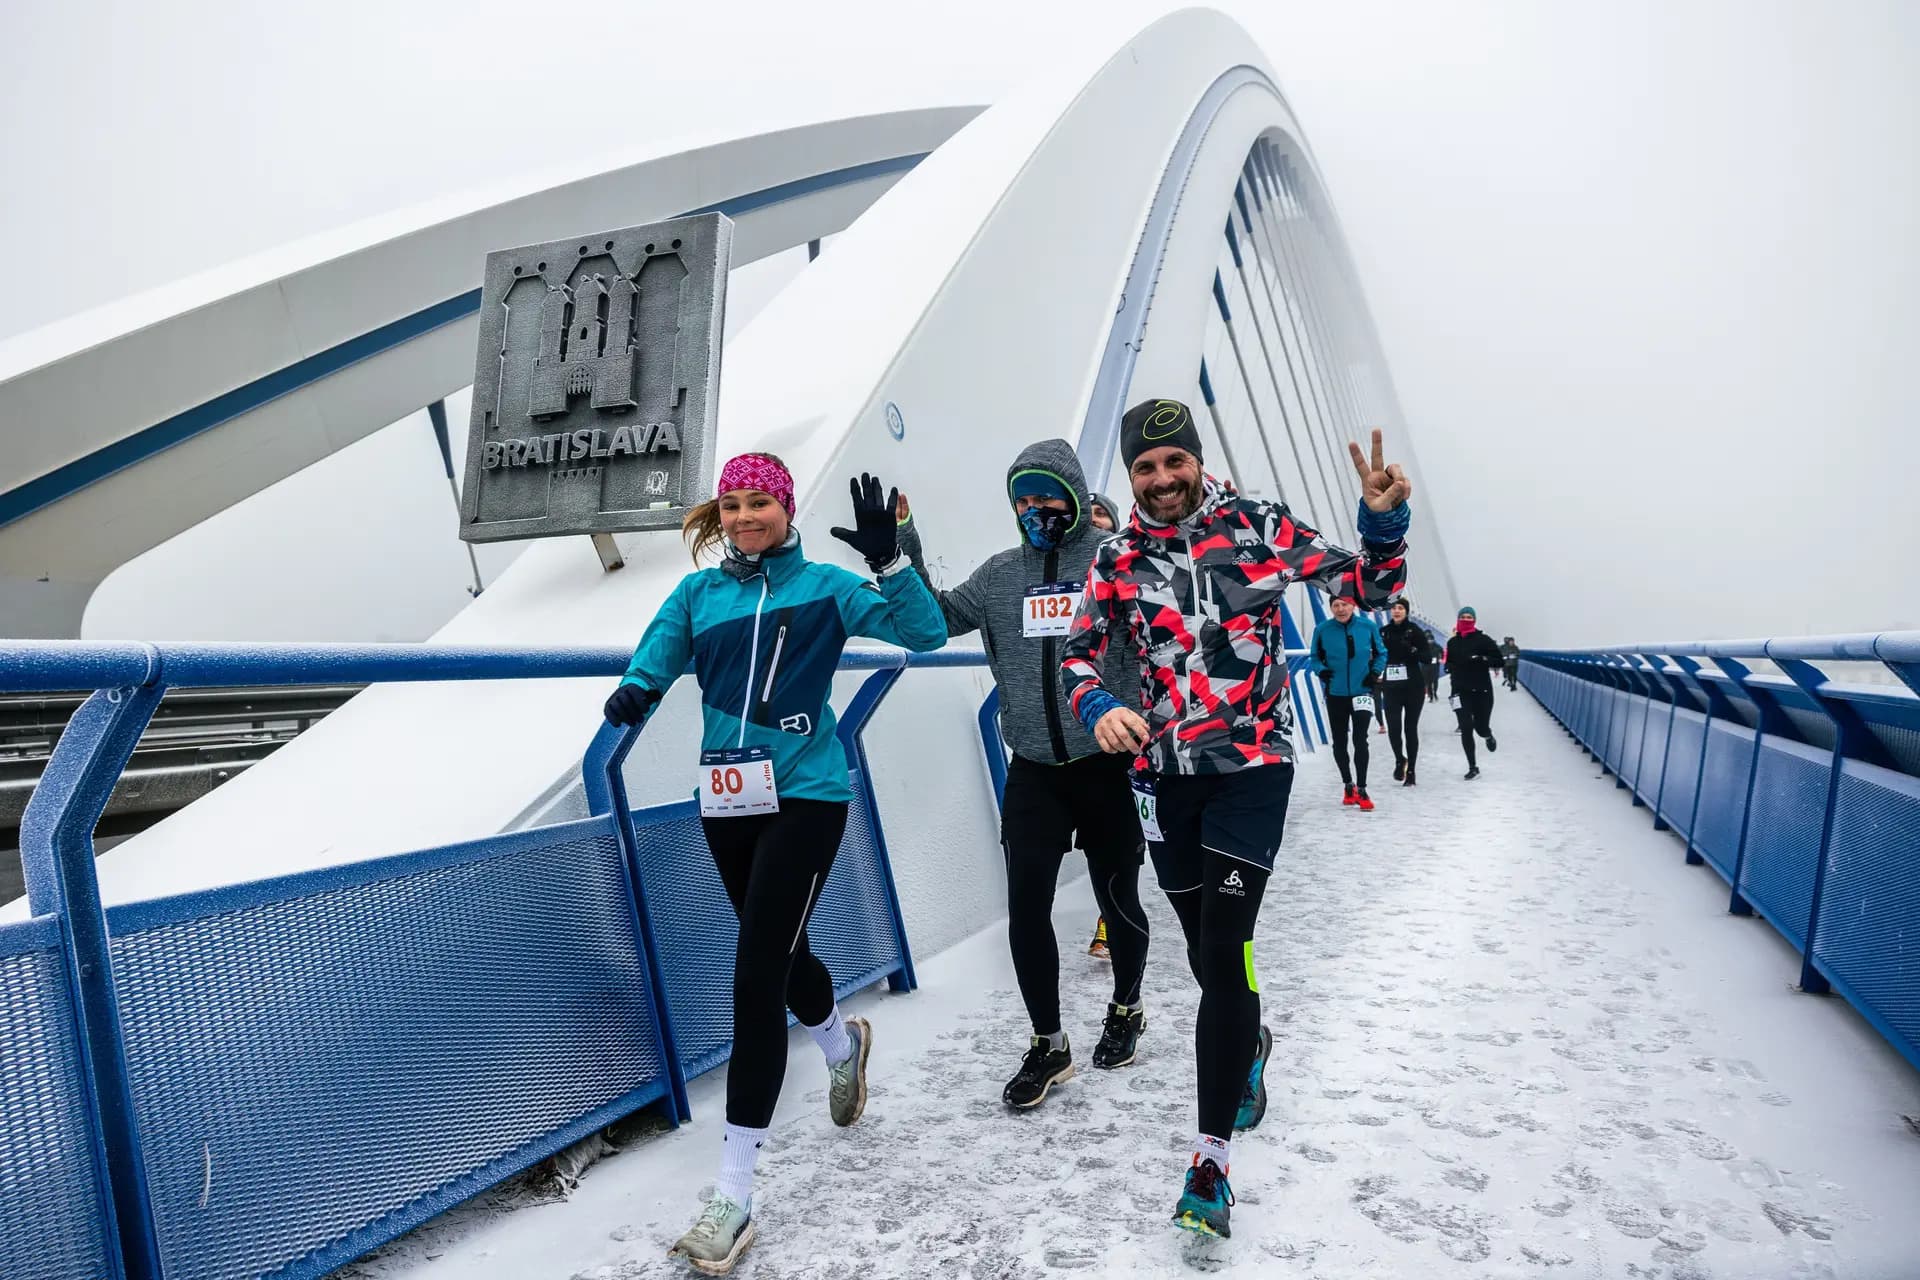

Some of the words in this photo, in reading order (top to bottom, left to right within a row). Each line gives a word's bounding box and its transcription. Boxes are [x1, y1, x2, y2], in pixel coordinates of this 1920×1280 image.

[482, 422, 680, 469] BRATISLAVA
[1029, 596, 1072, 619] 1132
[711, 767, 743, 795] 80
